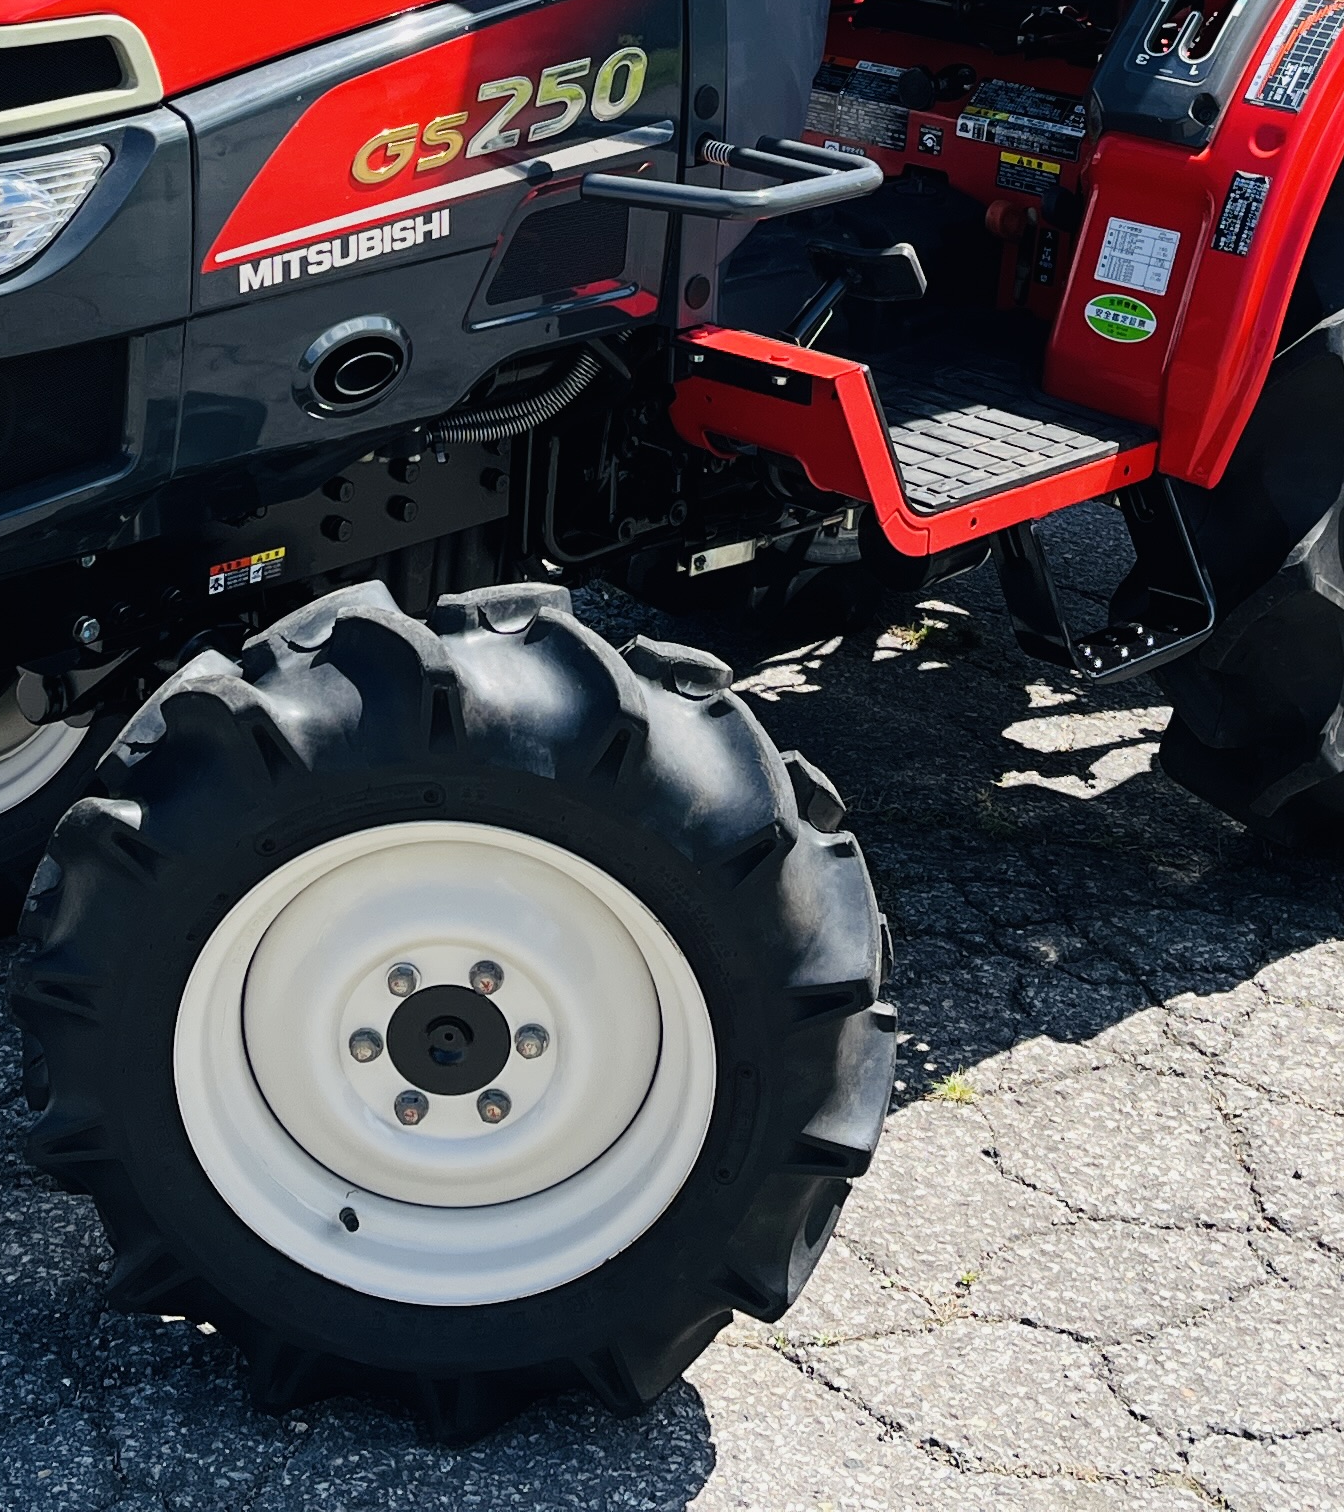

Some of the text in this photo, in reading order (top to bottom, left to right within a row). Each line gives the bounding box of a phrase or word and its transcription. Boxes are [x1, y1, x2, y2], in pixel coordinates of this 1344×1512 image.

[1135, 53, 1150, 65] 3
[1188, 64, 1199, 76] 1
[238, 208, 451, 296] MITSUBISHI
